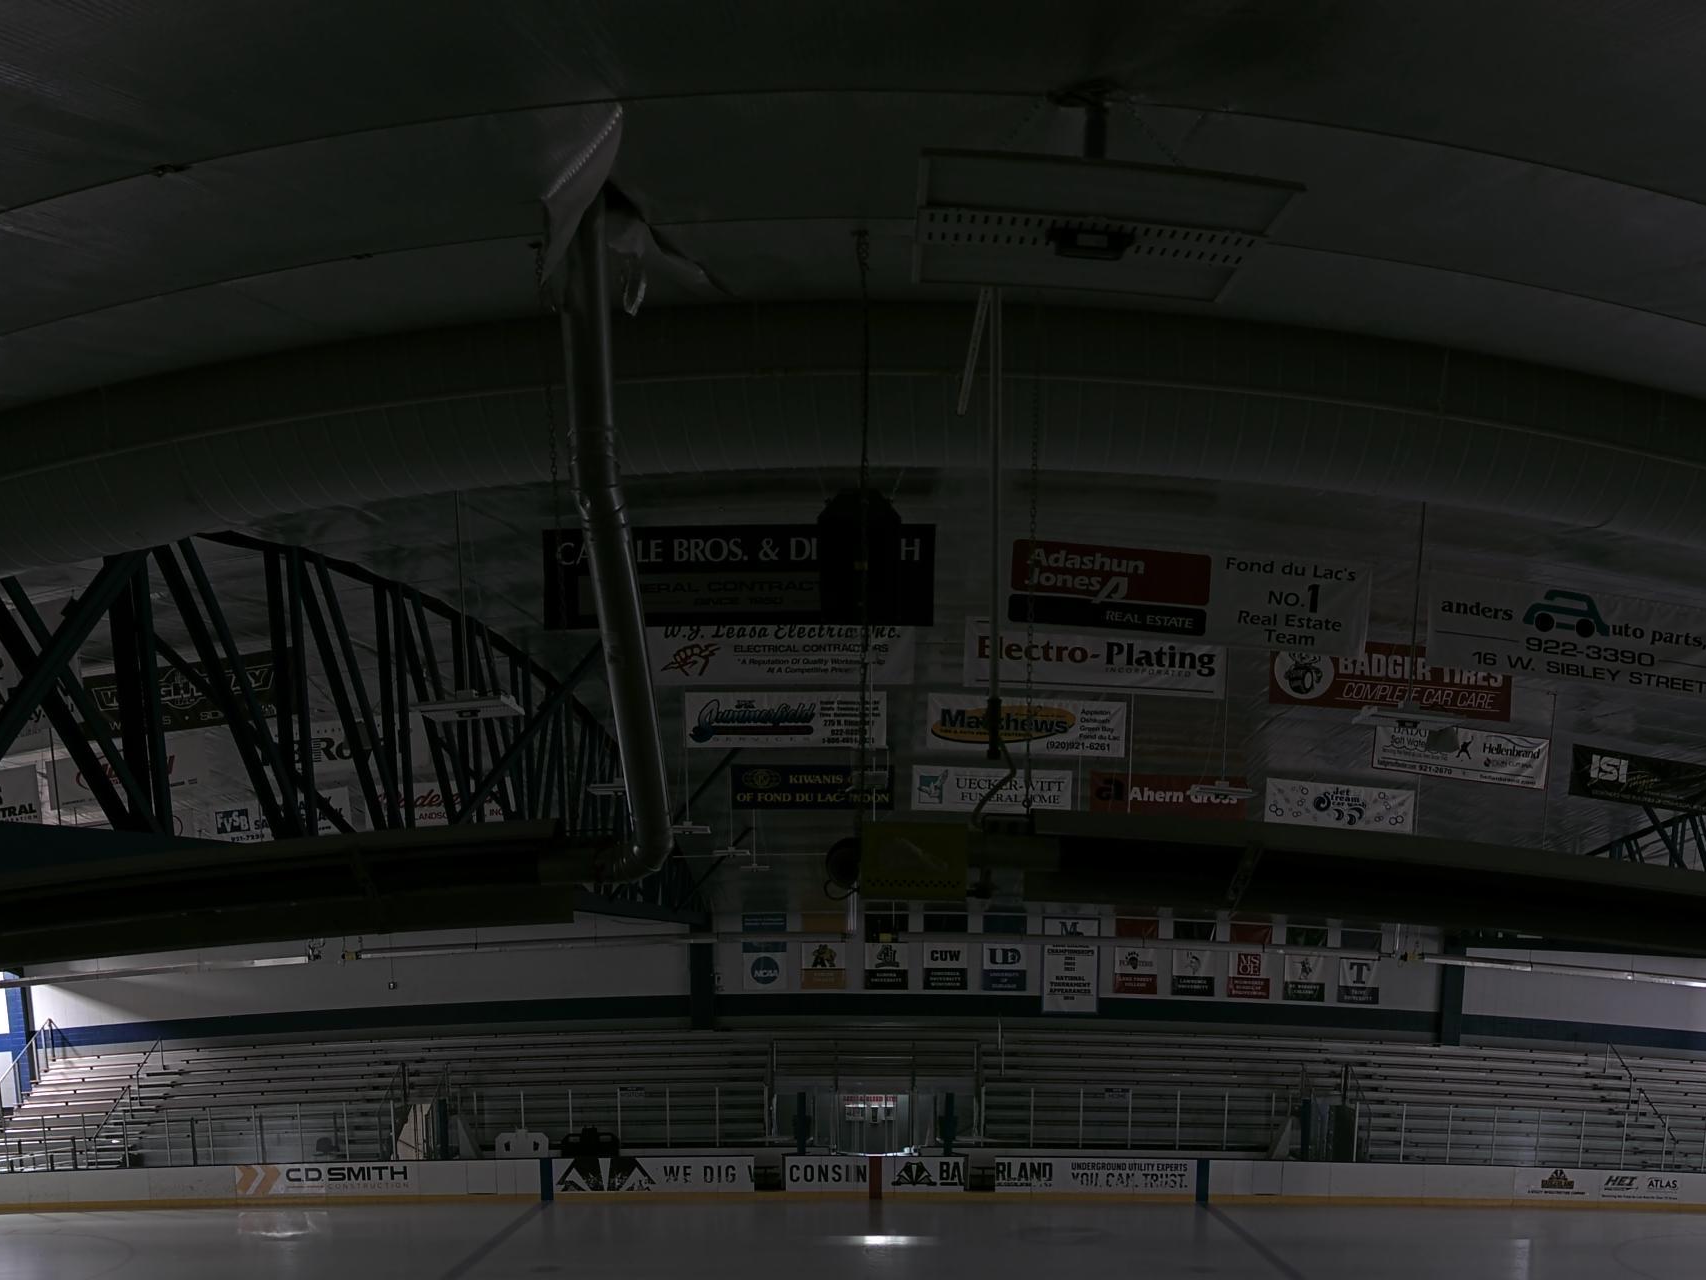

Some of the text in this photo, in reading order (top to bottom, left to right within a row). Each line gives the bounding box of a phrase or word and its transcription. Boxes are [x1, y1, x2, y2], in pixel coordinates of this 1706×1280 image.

[673, 537, 749, 563] BROS.
[757, 538, 780, 562] &
[1027, 546, 1146, 577] Adashun
[1226, 557, 1357, 582] Fond du Lac's
[1024, 567, 1101, 592] Jones
[1104, 610, 1195, 630] REAL ESTATE
[1238, 610, 1342, 632] Real Estate
[1441, 600, 1513, 621] anders
[1650, 628, 1706, 650] parts,
[1263, 629, 1315, 646] Team
[804, 644, 888, 653] CONTRACRS
[1525, 638, 1655, 667] 922-3390
[1473, 651, 1706, 694] 16 W. SIBLEY STREET
[1423, 688, 1452, 706] CAR
[1457, 691, 1494, 709] CARE
[941, 707, 1069, 734] Mahews
[1408, 737, 1428, 748] Wate
[788, 774, 843, 785] KIWANIS
[737, 792, 814, 803] OF FOND DU
[1128, 787, 1185, 803] Ahern
[930, 949, 960, 962] CUW
[328, 1165, 409, 1183] SMITH
[704, 1164, 737, 1184] DIG
[790, 1164, 867, 1184] CONSIN
[1071, 1162, 1188, 1172] UNDERGROUND UTILITY EXPERTS
[1648, 1179, 1678, 1189] ATLAS
